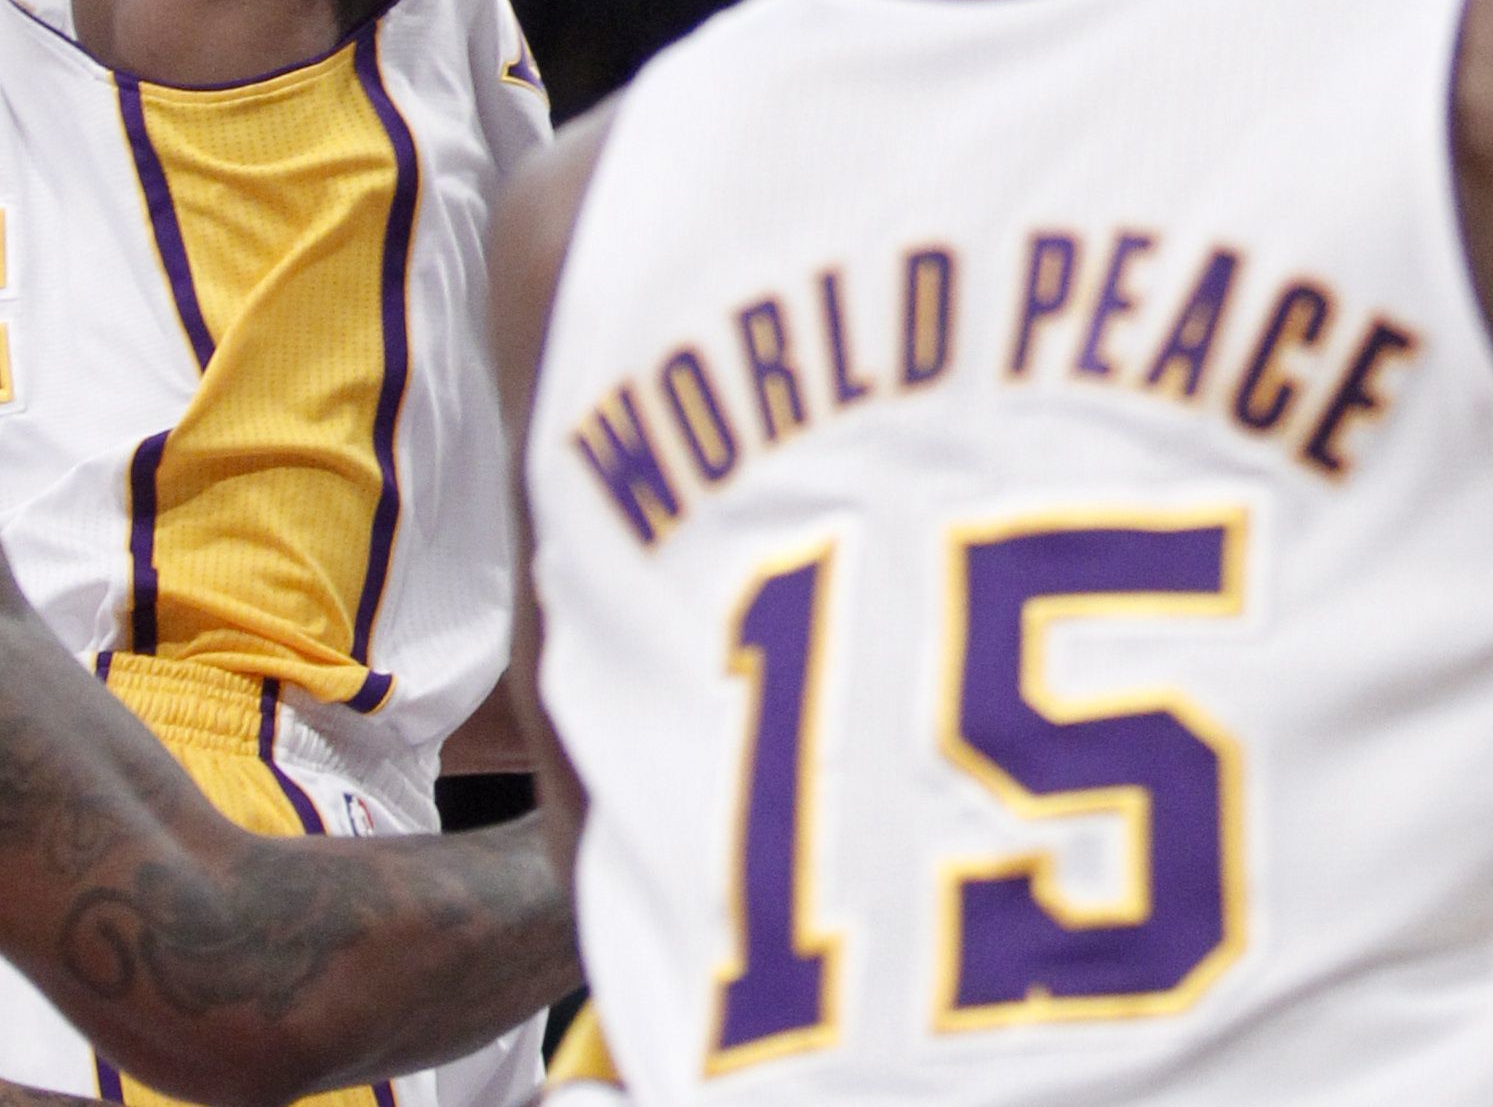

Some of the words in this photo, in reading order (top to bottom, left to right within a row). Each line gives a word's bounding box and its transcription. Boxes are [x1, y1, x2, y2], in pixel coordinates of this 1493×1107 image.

[567, 246, 958, 550] WORLD
[1003, 226, 1422, 482] PEACE
[700, 502, 1247, 1078] 15
